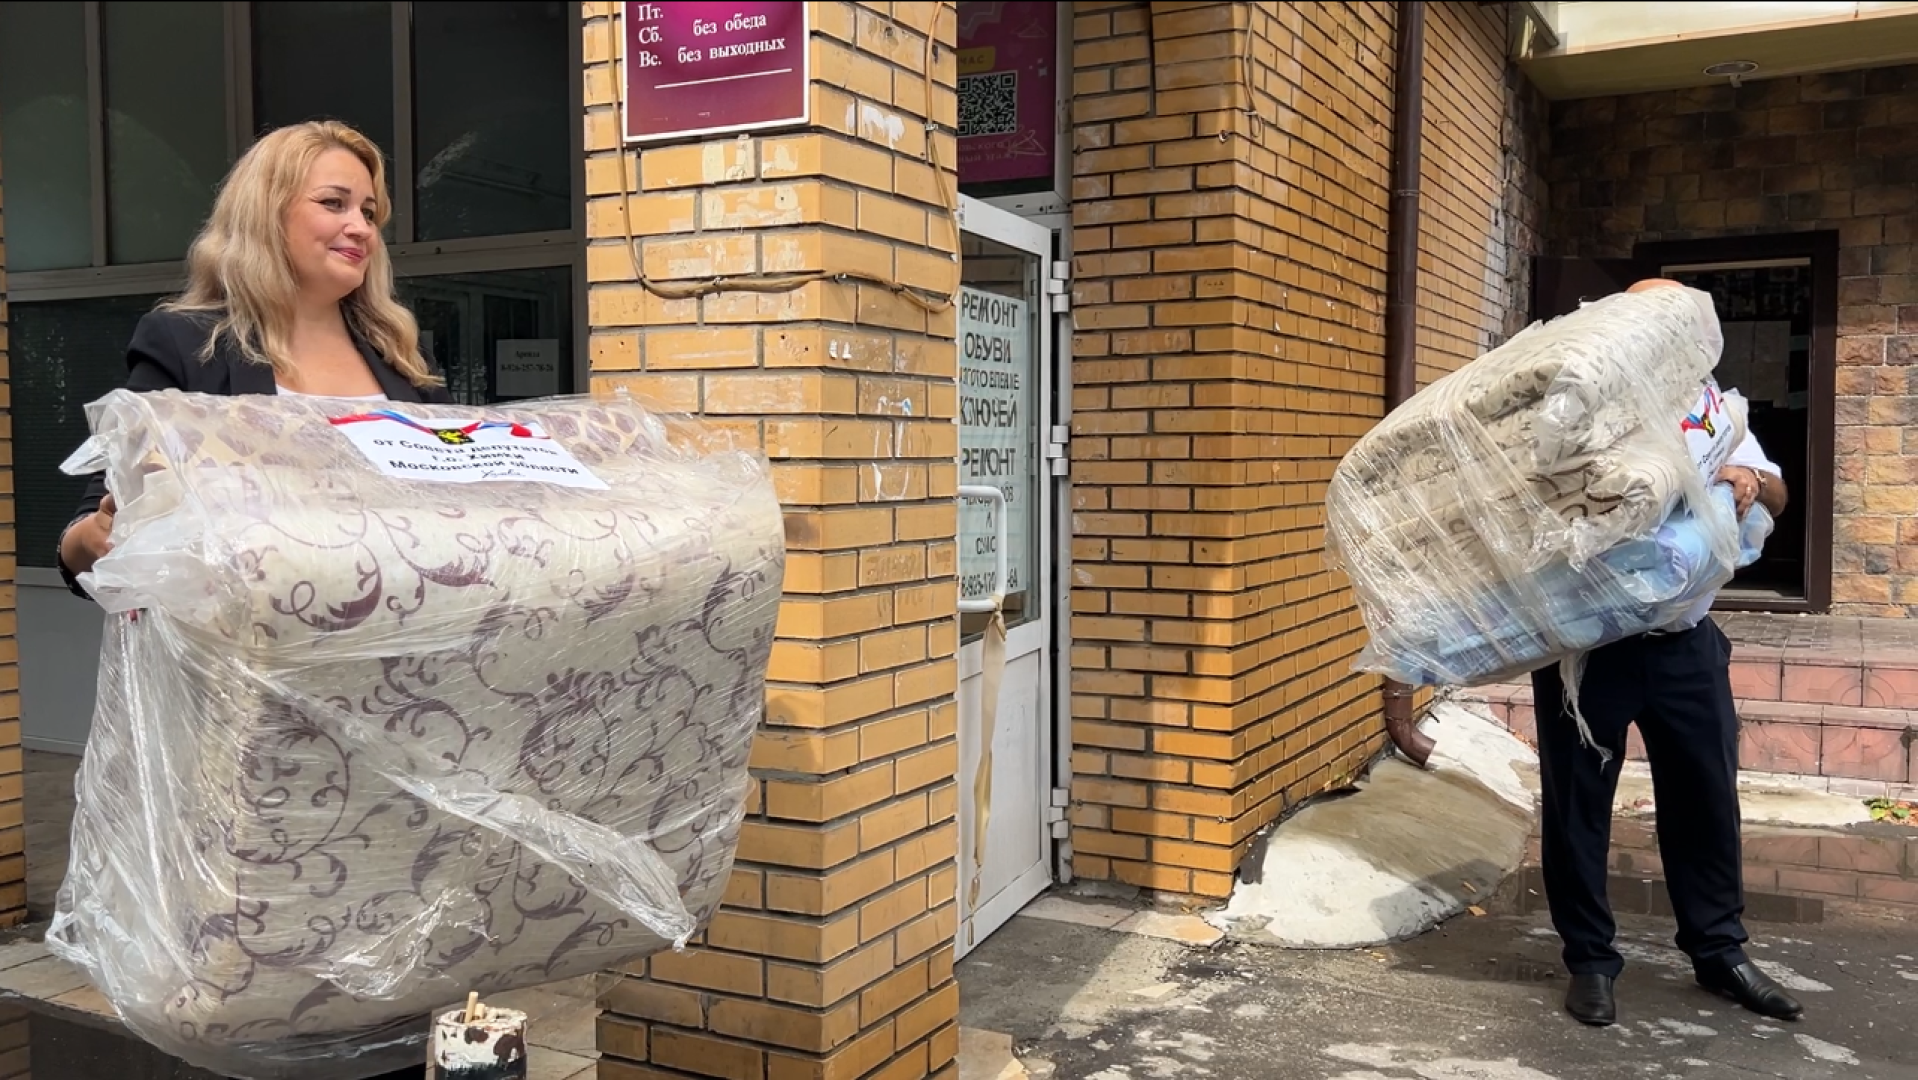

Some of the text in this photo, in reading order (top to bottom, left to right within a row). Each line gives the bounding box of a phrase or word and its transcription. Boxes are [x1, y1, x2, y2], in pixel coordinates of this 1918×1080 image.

[638, 4, 664, 21] Пт.
[638, 12, 767, 44] Сб. без обеда
[639, 38, 786, 67] Вс. без выходных
[961, 292, 1018, 328] РЕМОНТ
[964, 333, 1011, 363] ОБУВИ
[960, 394, 1018, 427] КЛЮЧЕЙ
[961, 448, 1016, 477] РЕМОНТ
